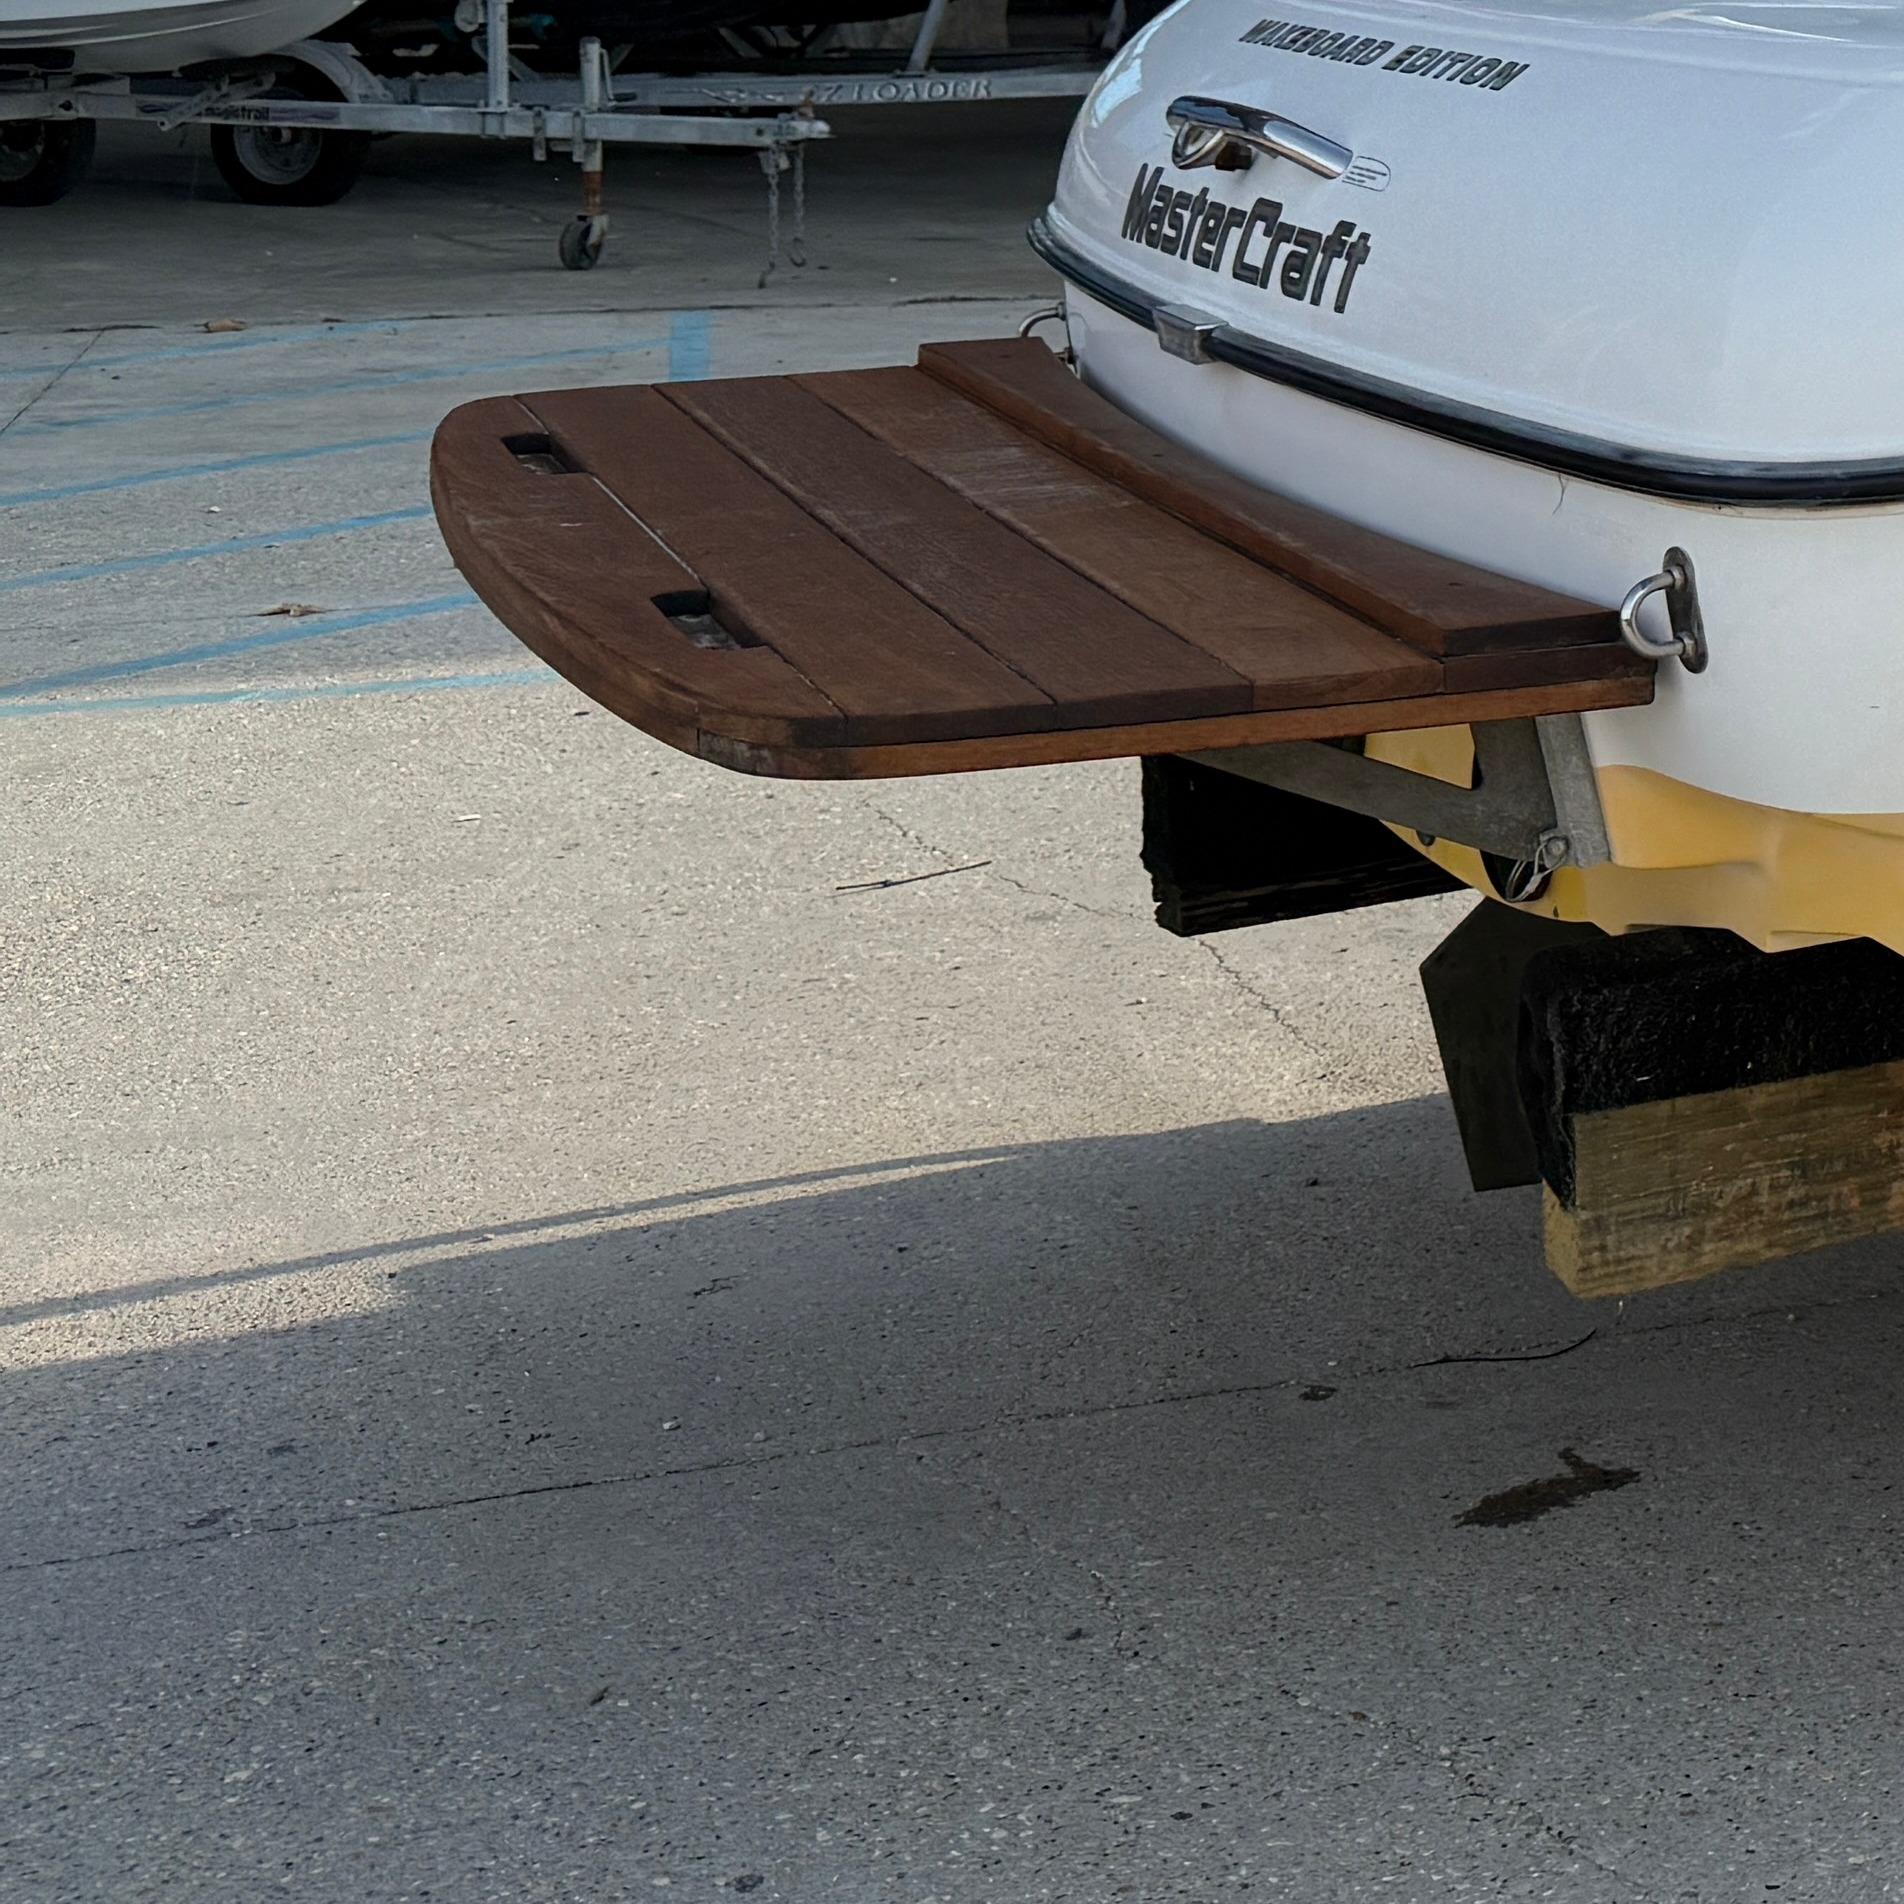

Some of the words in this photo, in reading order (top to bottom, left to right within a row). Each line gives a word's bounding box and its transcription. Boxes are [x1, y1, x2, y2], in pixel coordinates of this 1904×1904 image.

[1238, 18, 1396, 66] WAKEBOARD
[1381, 44, 1531, 92] EDITION
[1121, 162, 1372, 314] MasterCraft
